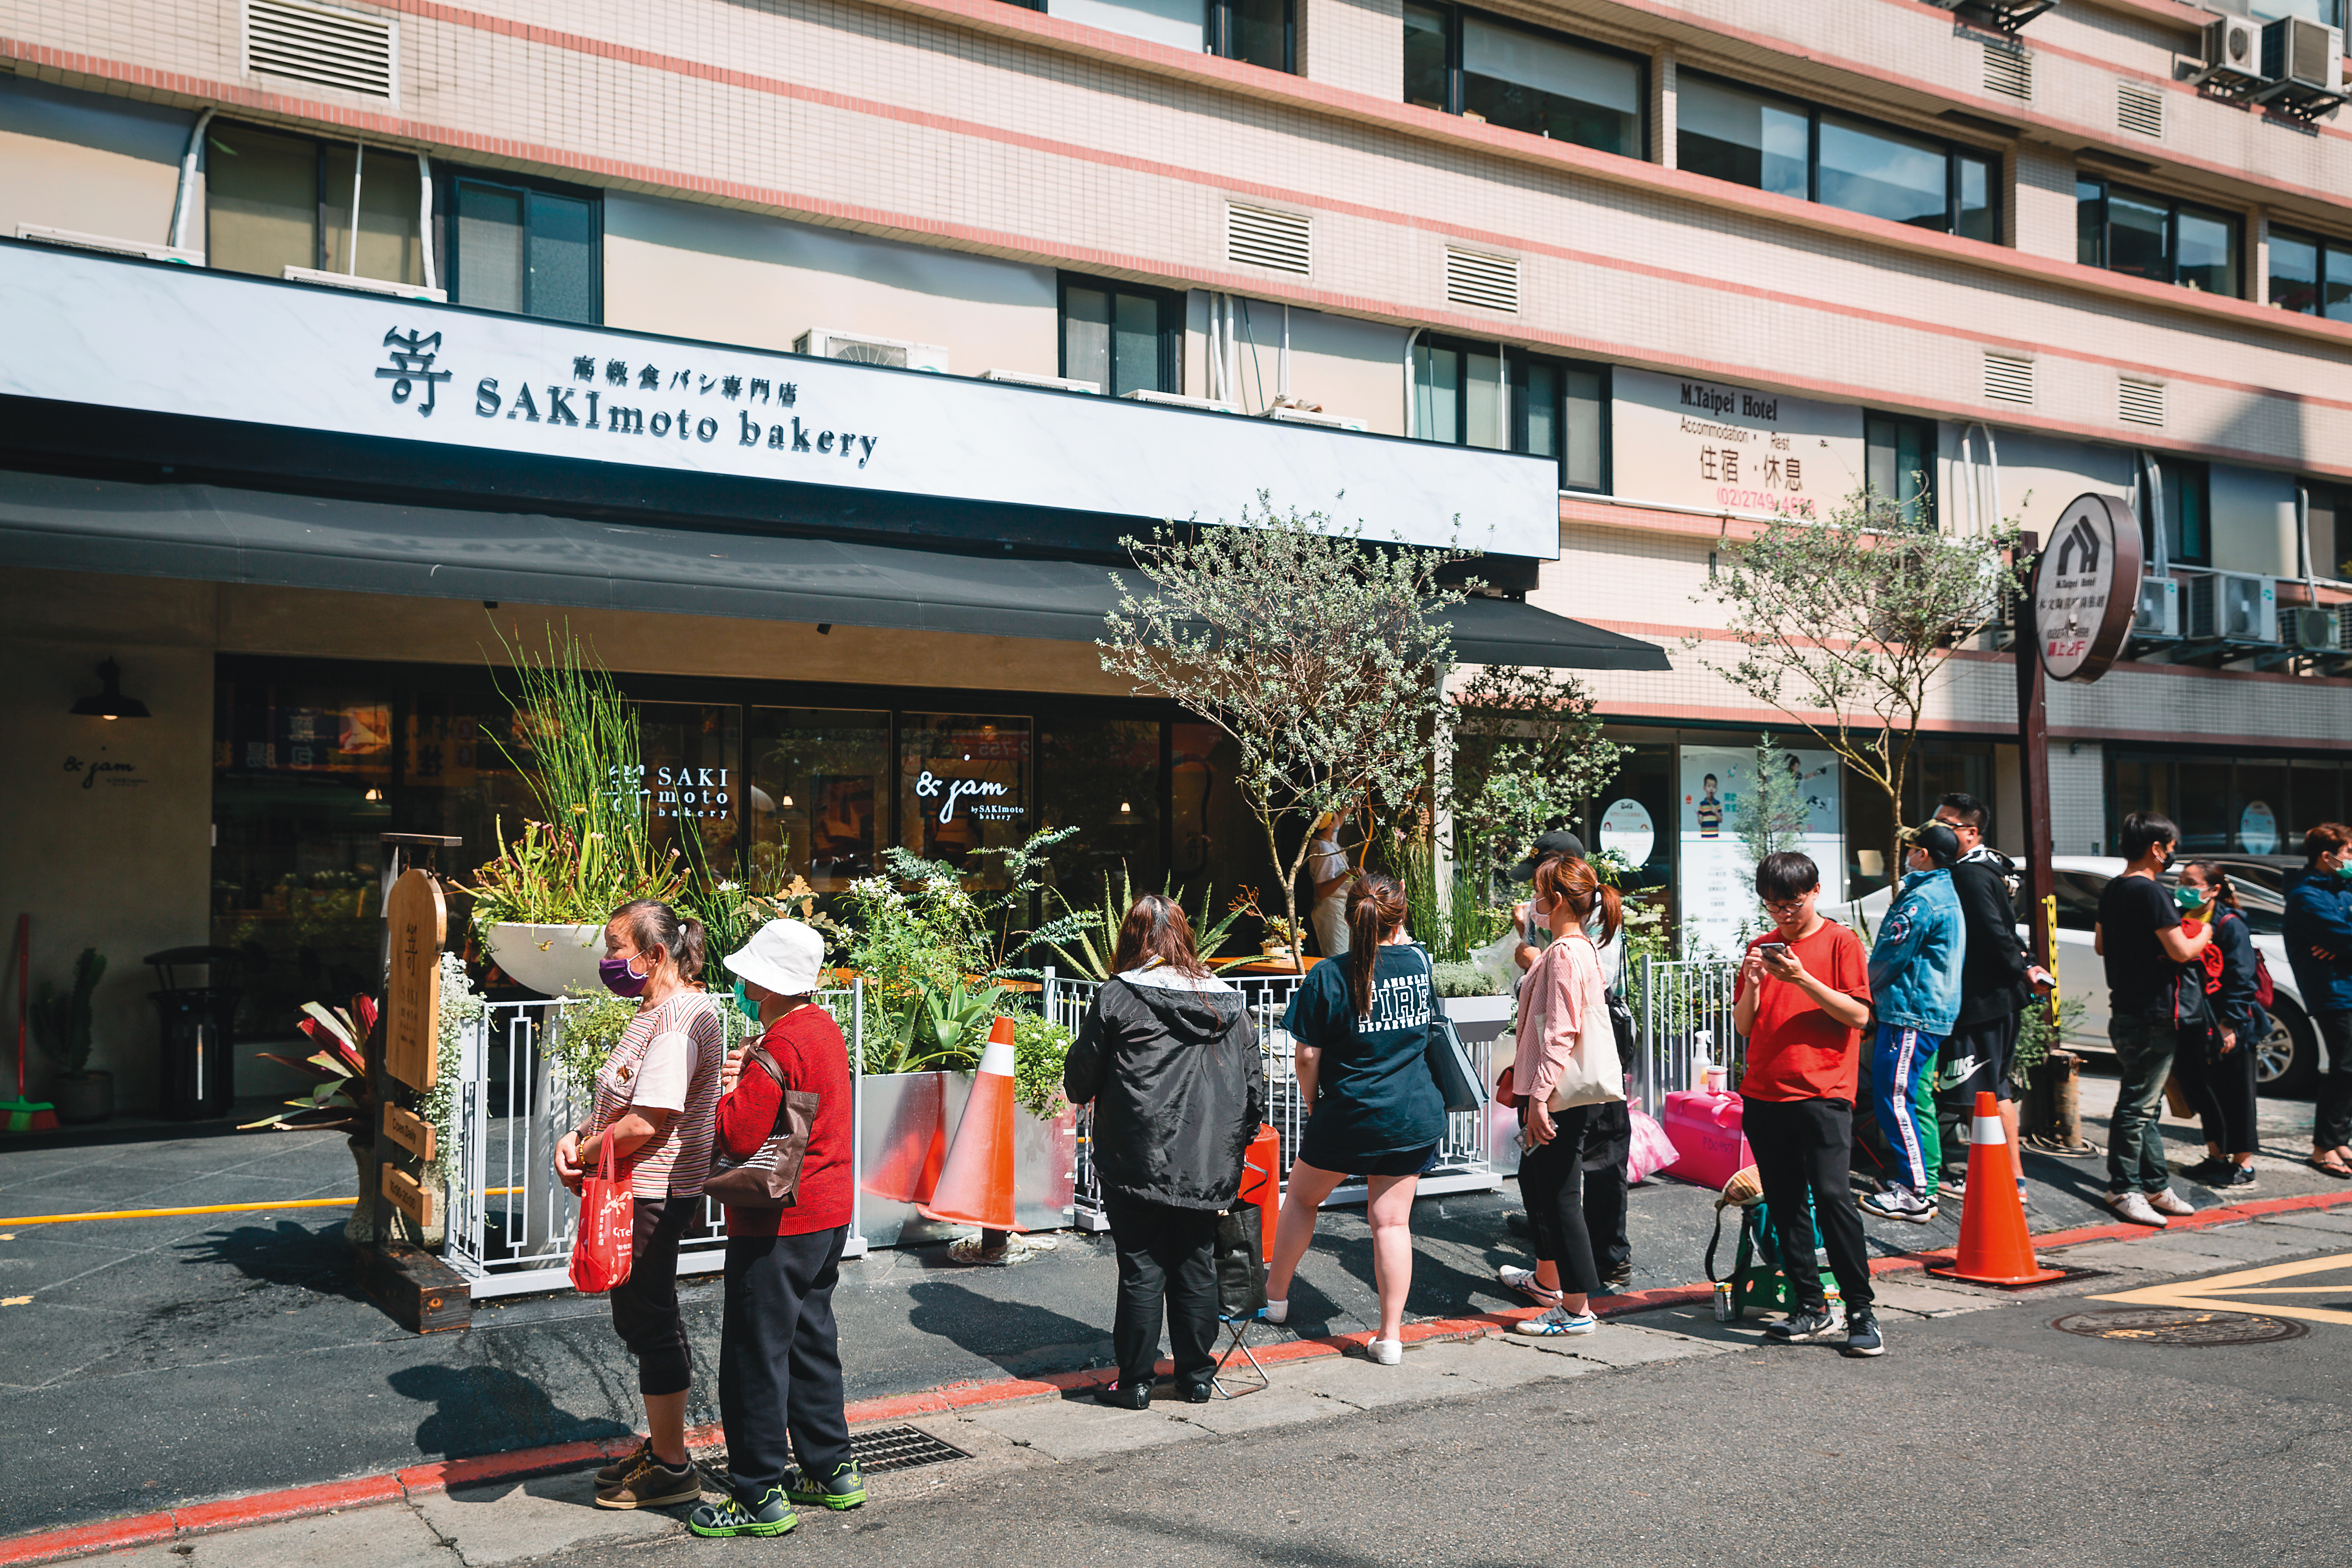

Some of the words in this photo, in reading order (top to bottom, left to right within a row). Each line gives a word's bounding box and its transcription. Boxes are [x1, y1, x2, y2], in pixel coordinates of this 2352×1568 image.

[1681, 383, 1735, 416] M.Taipei
[1742, 394, 1777, 421] Hotel
[475, 376, 719, 443] SAKImoto
[739, 409, 879, 468] bakery
[1680, 416, 1748, 443] Accommodation
[1771, 431, 1791, 451] Rest
[1700, 444, 1739, 483] 住宿
[1764, 454, 1803, 492] 休息
[63, 756, 85, 772] &
[82, 746, 136, 789] jam
[658, 766, 728, 786] SAKI
[658, 789, 728, 804] moto
[916, 771, 943, 796] &
[939, 754, 1008, 824] jam
[658, 808, 728, 820] bakery
[980, 813, 1011, 822] bakery
[392, 1118, 405, 1134] Open
[405, 1125, 416, 1144] Daily
